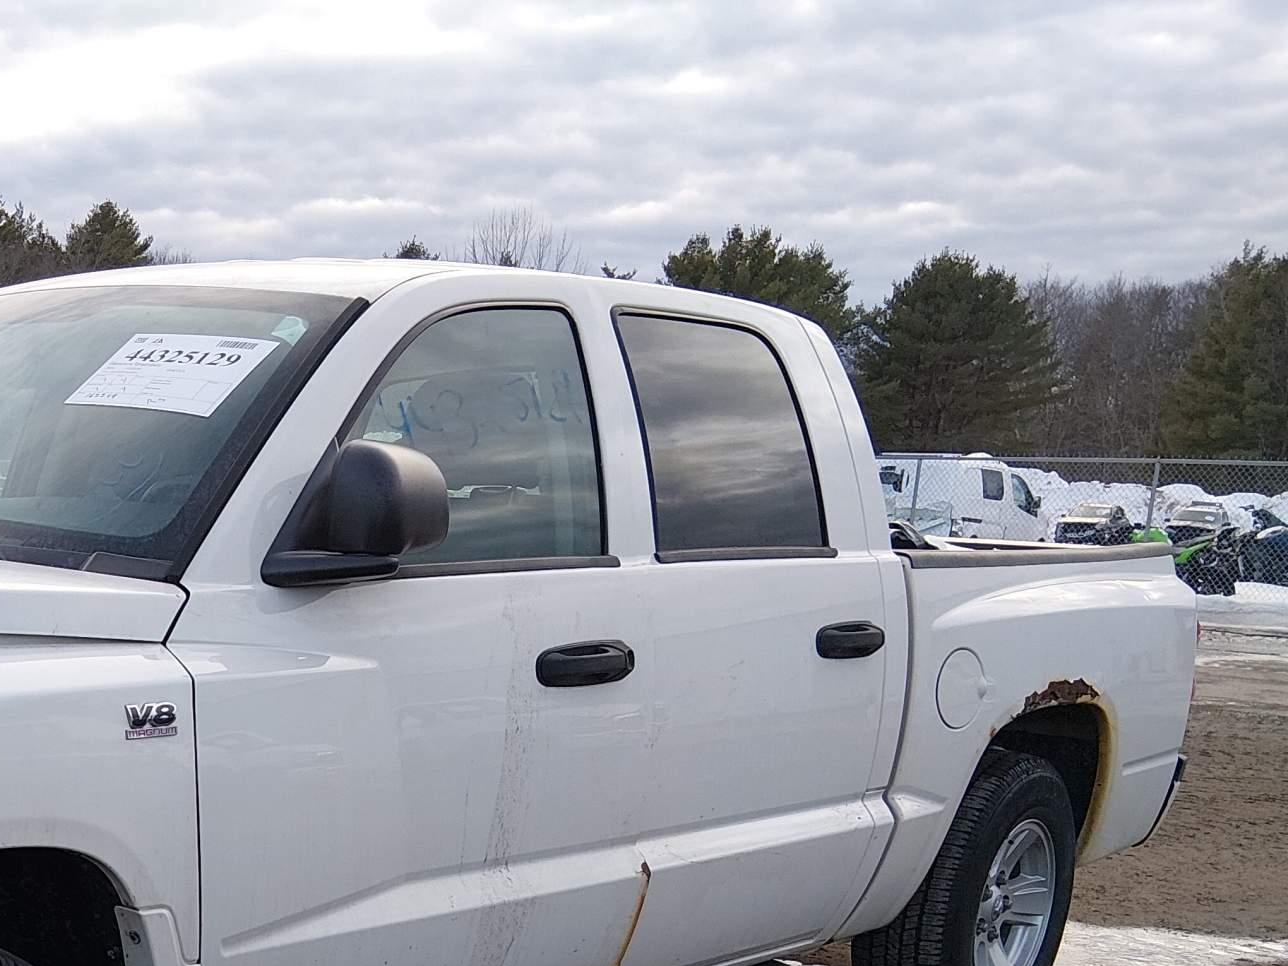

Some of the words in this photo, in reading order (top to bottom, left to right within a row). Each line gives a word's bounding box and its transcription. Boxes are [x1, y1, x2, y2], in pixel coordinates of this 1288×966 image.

[125, 348, 242, 367] 44325129
[124, 701, 177, 729] V8
[126, 727, 177, 739] MAGNUM
